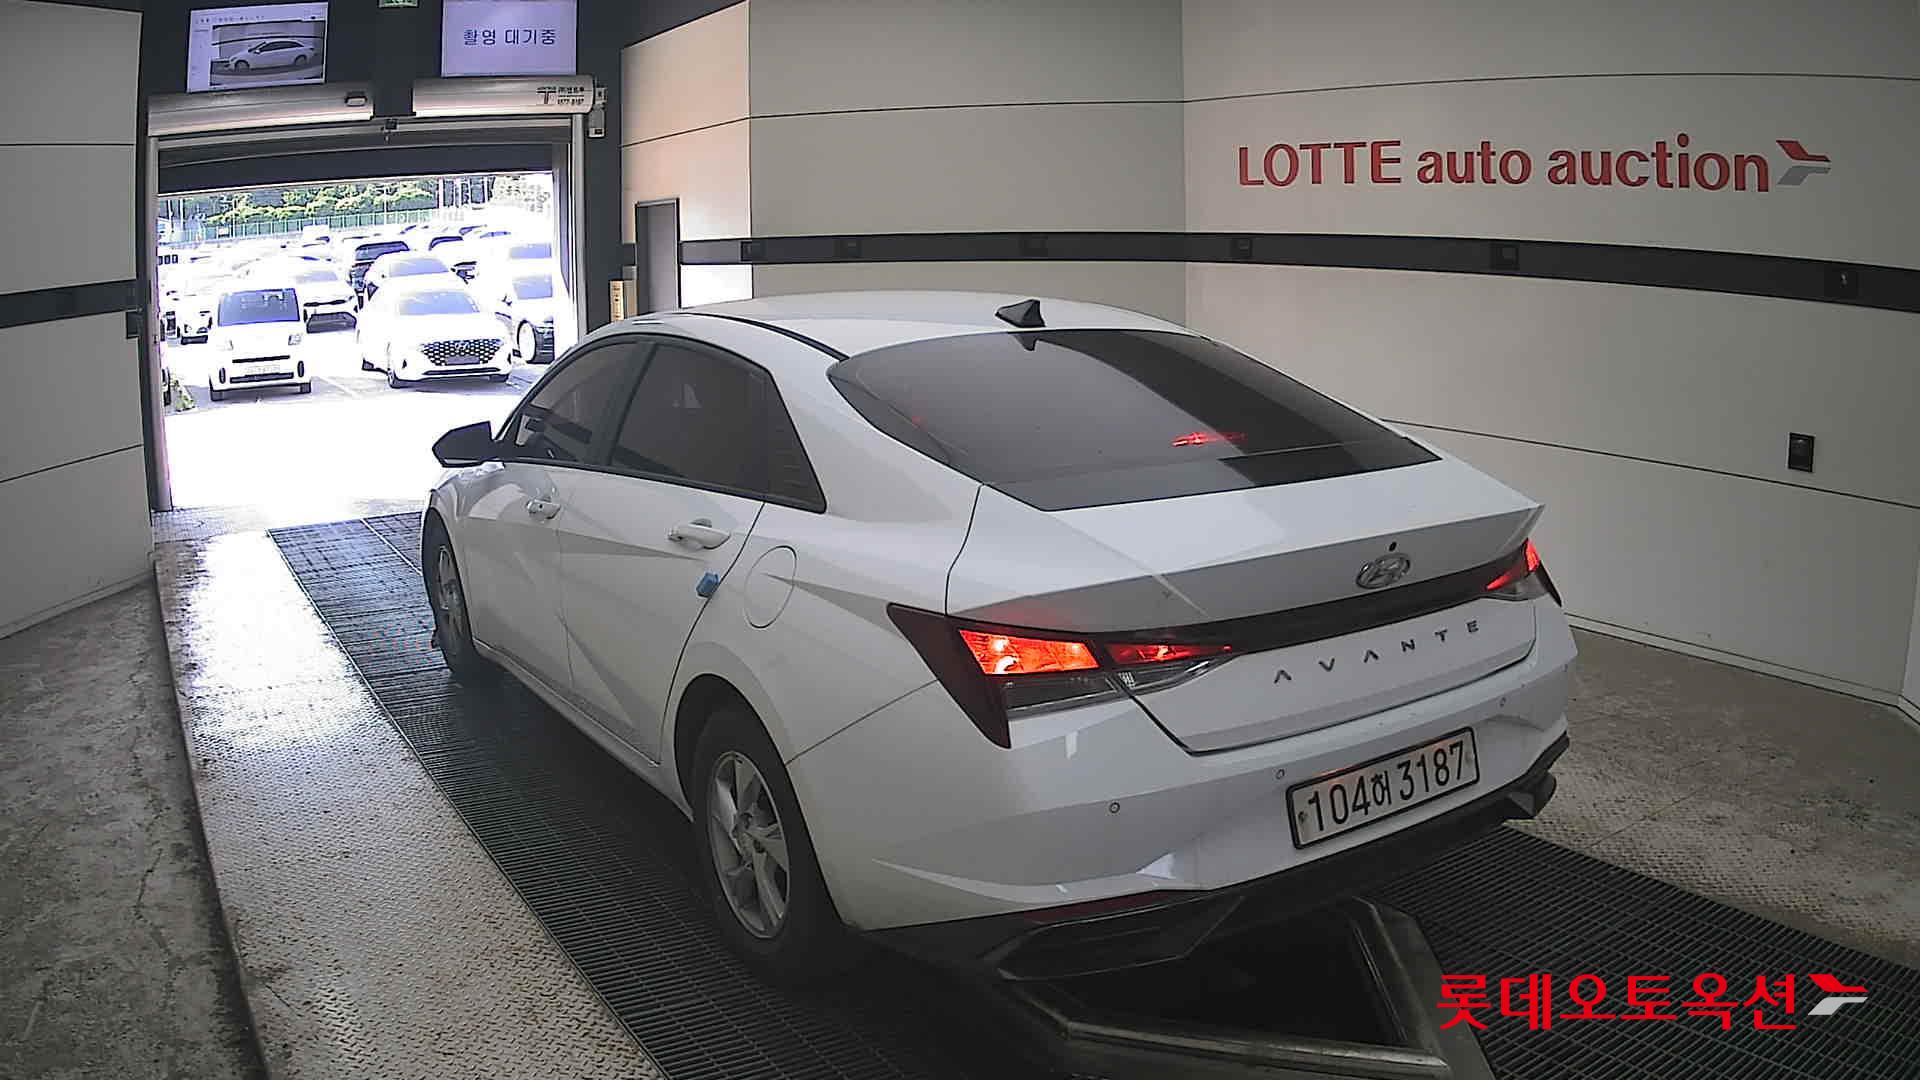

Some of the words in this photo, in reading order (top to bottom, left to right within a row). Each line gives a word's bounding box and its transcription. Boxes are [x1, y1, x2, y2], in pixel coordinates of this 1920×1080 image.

[464, 29, 496, 46] 촬영
[505, 29, 556, 45] 대기중
[1238, 139, 1401, 188] LOTTE
[1416, 141, 1532, 185] auto
[1547, 133, 1769, 192] auction
[1273, 620, 1480, 684] AVANTE
